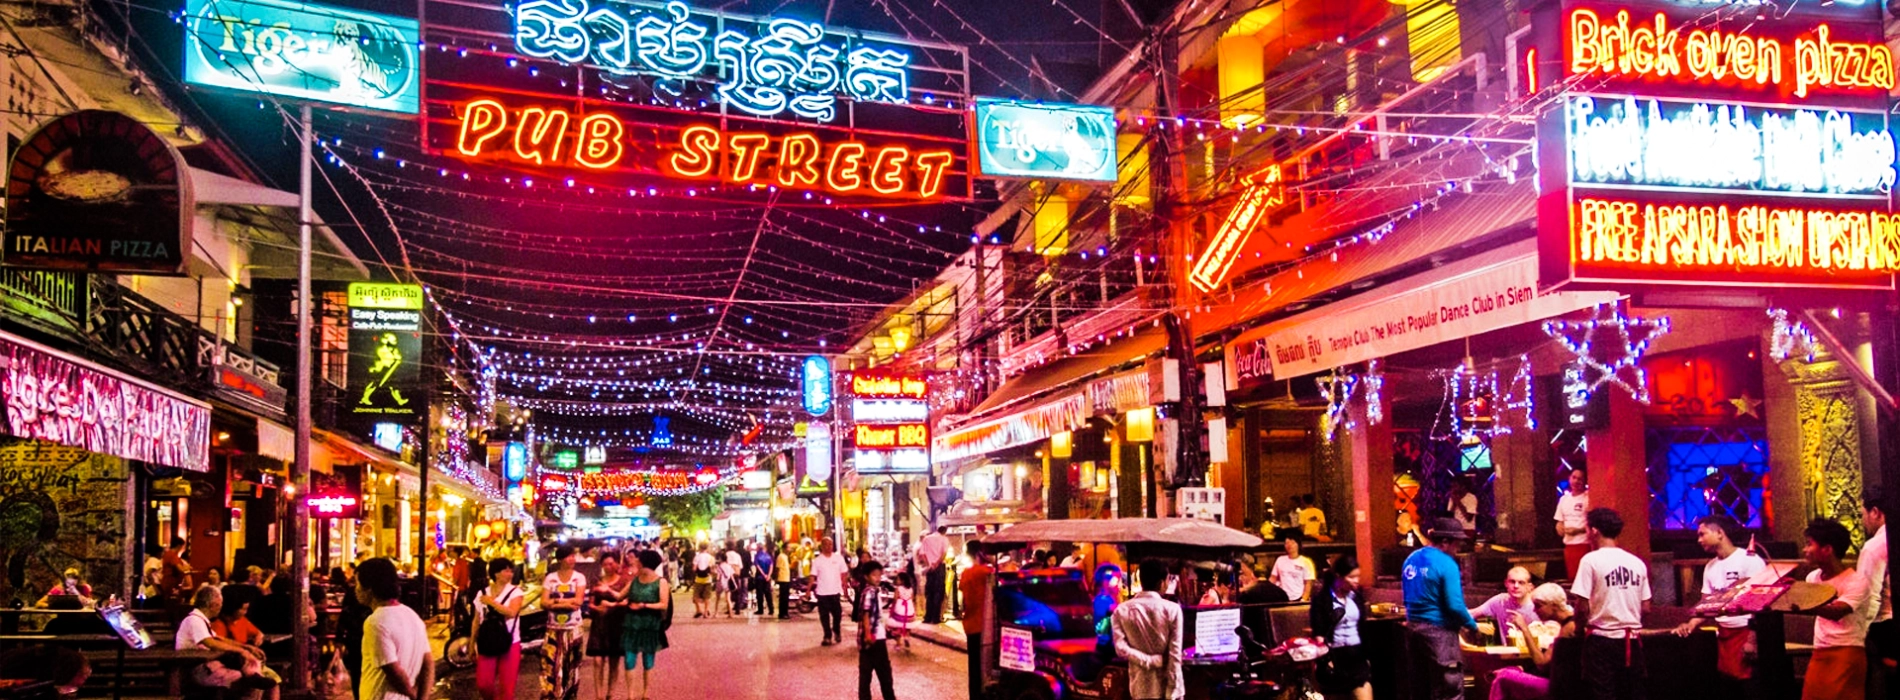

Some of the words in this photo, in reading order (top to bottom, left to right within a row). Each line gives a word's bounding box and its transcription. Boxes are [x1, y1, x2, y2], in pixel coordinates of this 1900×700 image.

[213, 14, 333, 75] Tiger
[1571, 9, 1681, 76] Brick
[1687, 29, 1781, 84] oven
[1795, 24, 1895, 97] pizza
[457, 99, 624, 169] PUB
[671, 126, 953, 197] STREET
[1576, 95, 1642, 180] Food
[16, 235, 101, 255] ITALIAN
[110, 239, 169, 259] PIZZA
[1581, 199, 1638, 262] FREE
[1641, 205, 1734, 265] APSARA
[1733, 206, 1803, 268] SHOW
[1808, 210, 1900, 271] UPSTAIRS
[351, 309, 376, 321] Easy
[381, 310, 420, 323] Speaking
[1329, 337, 1353, 352] Temple
[1354, 330, 1369, 346] Club
[1370, 324, 1385, 339] The
[1386, 318, 1406, 337] Most
[1407, 311, 1438, 331] Popular
[1440, 303, 1469, 323] Dance
[1472, 292, 1494, 315] Club
[1496, 293, 1505, 309] in
[1507, 284, 1533, 306] Siem
[856, 425, 896, 446] Khmer
[898, 425, 926, 446] BBQ
[1604, 565, 1640, 587] TEMPLE
